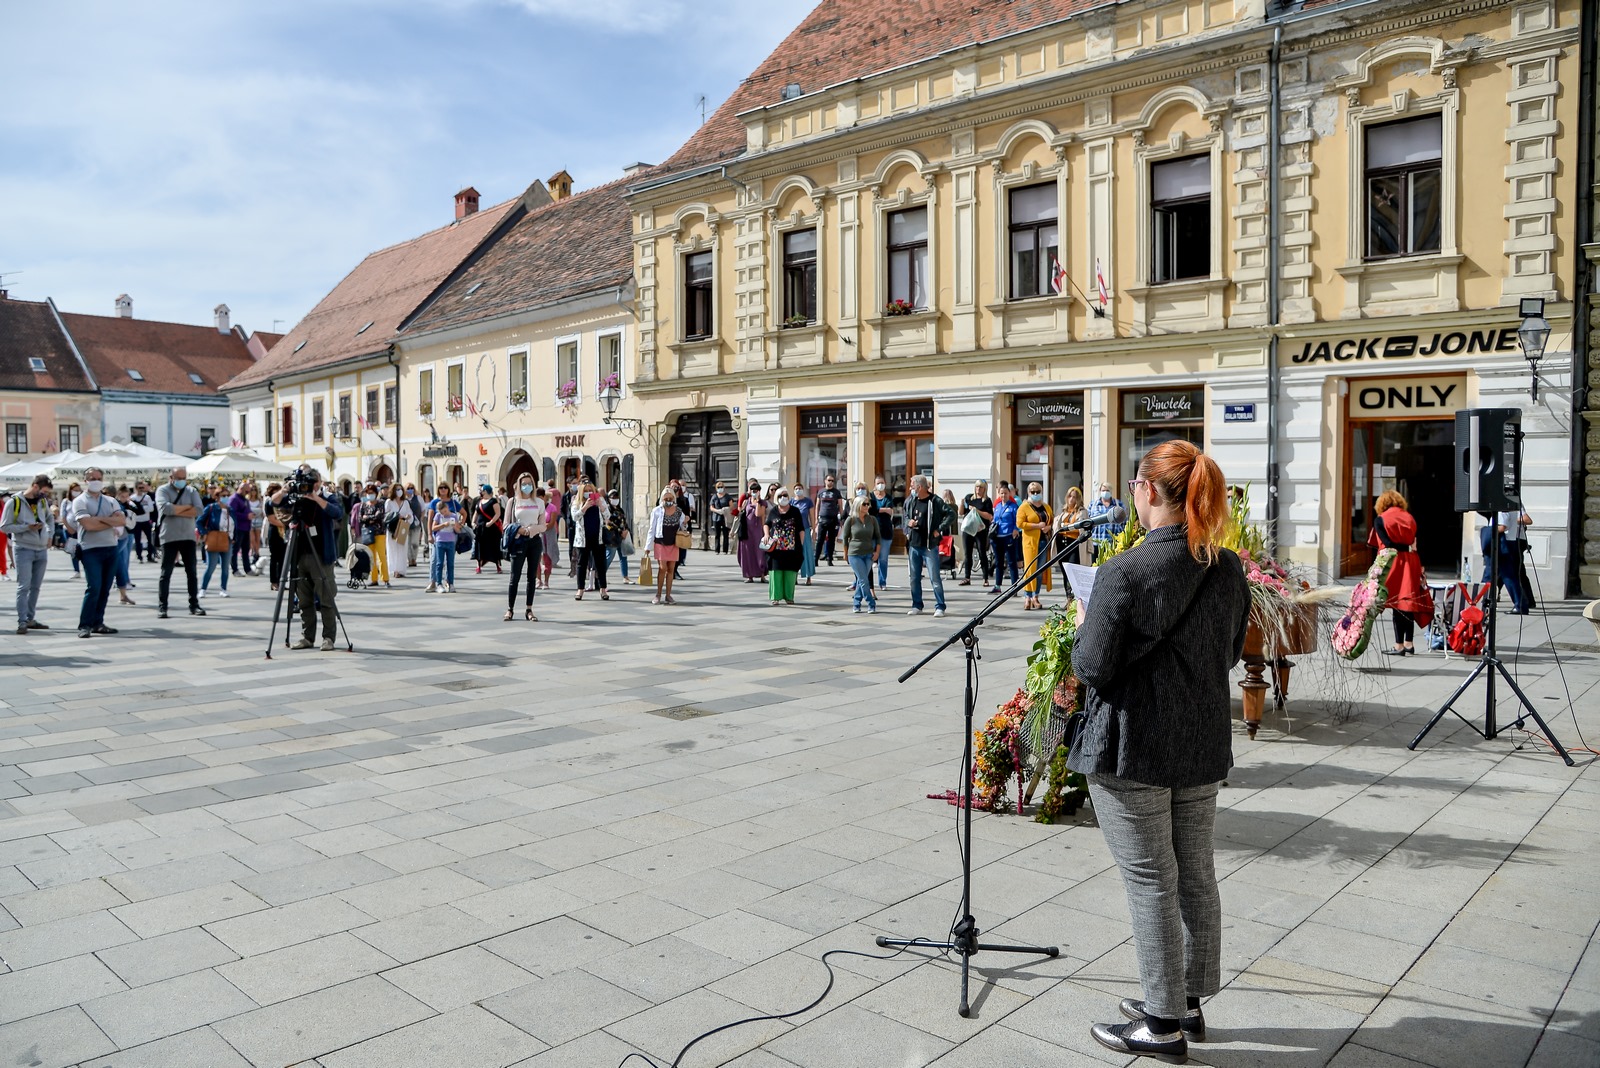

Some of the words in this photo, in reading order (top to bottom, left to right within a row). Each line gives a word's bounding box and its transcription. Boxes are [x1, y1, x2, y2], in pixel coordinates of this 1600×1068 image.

[1292, 337, 1383, 364] JACK
[1418, 327, 1524, 356] JONE
[1140, 394, 1191, 412] Vinoteka
[1358, 383, 1457, 409] ONLY
[890, 410, 932, 421] JADRAN
[1026, 399, 1081, 418] Suvenirnica
[808, 414, 847, 425] JADRAN
[554, 434, 586, 449] TISAK
